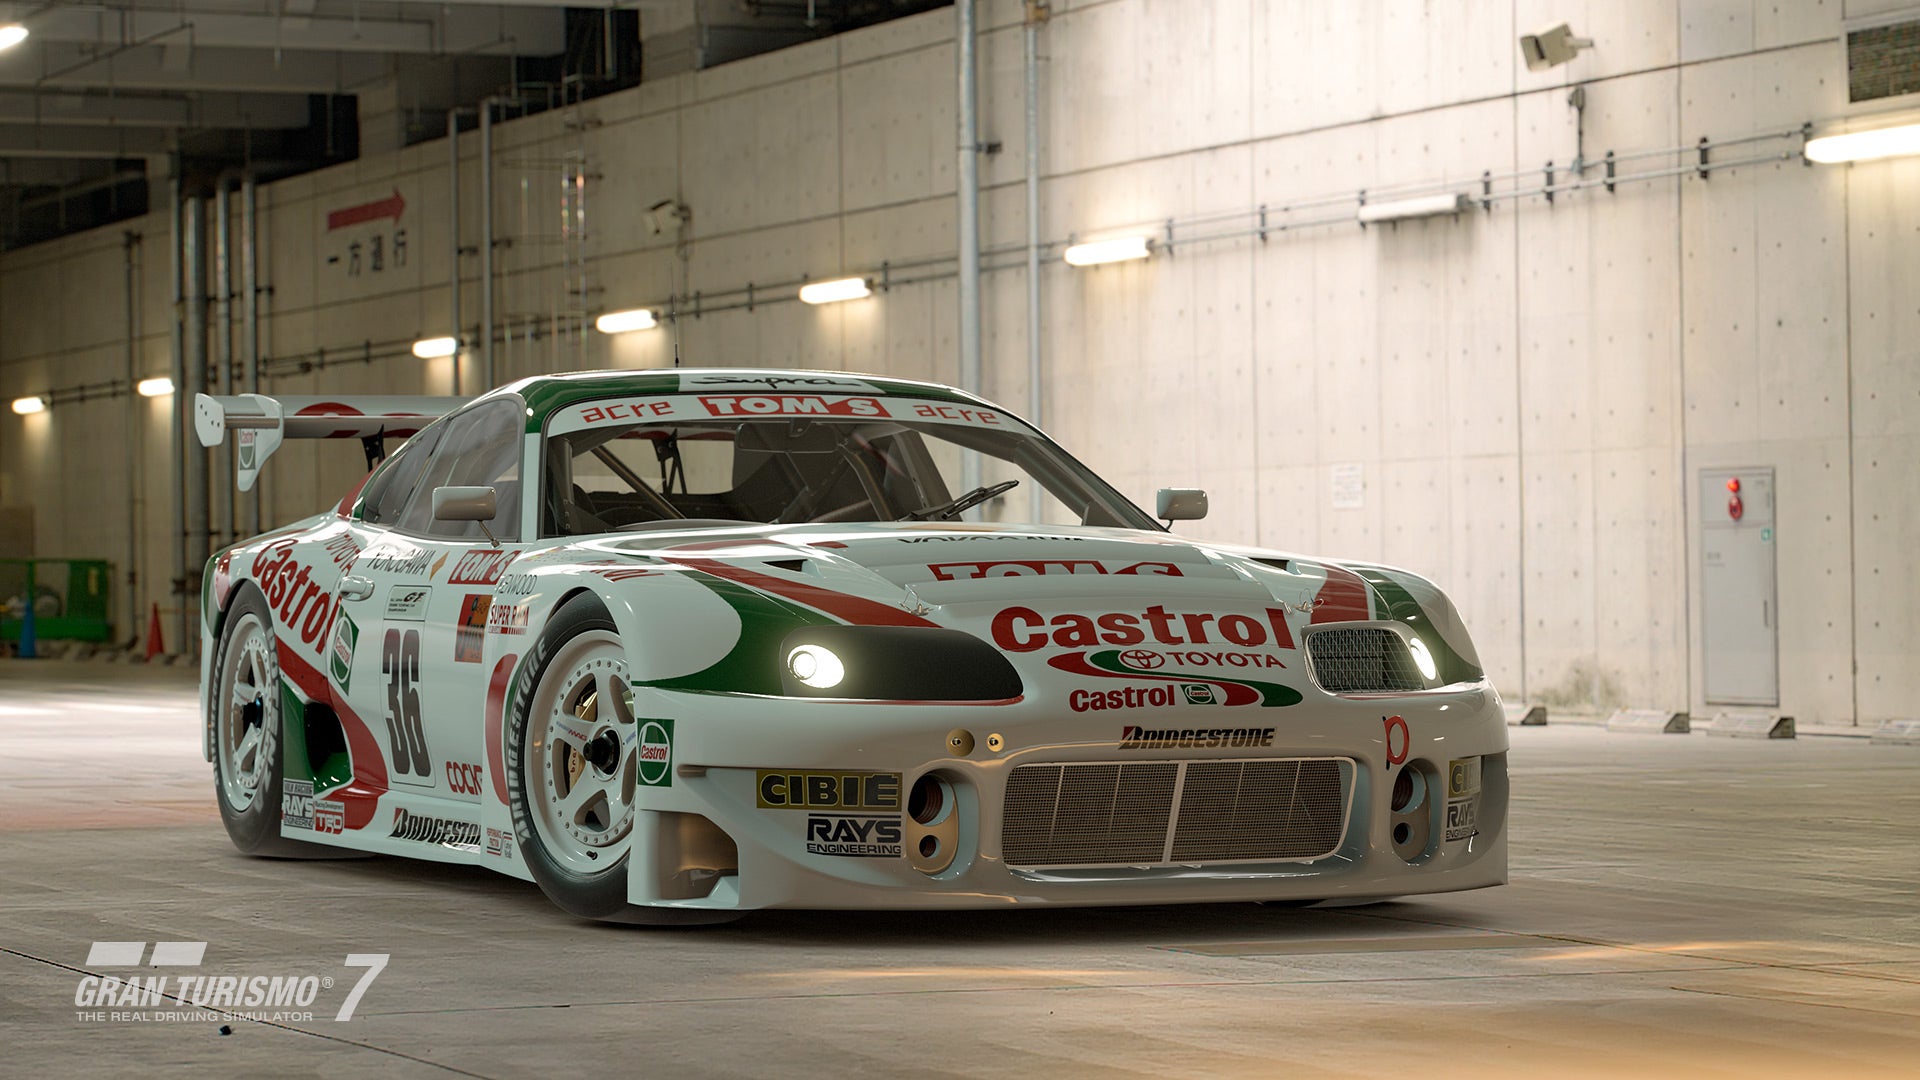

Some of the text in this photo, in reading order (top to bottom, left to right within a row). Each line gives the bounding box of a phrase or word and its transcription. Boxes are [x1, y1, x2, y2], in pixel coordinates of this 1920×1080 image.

[580, 401, 675, 423] acre
[912, 405, 1001, 424] acre
[252, 539, 342, 655] Castrol
[991, 605, 1297, 652] Castrol
[1170, 651, 1287, 669] TOYOTA
[382, 628, 431, 777] 36
[1069, 684, 1175, 713] Castrol
[1118, 726, 1276, 749] BRIDGESTONE
[640, 744, 668, 762] Castrol
[283, 795, 314, 817] RAYS
[807, 818, 901, 843] RAYS
[807, 843, 901, 854] ENGINEERING
